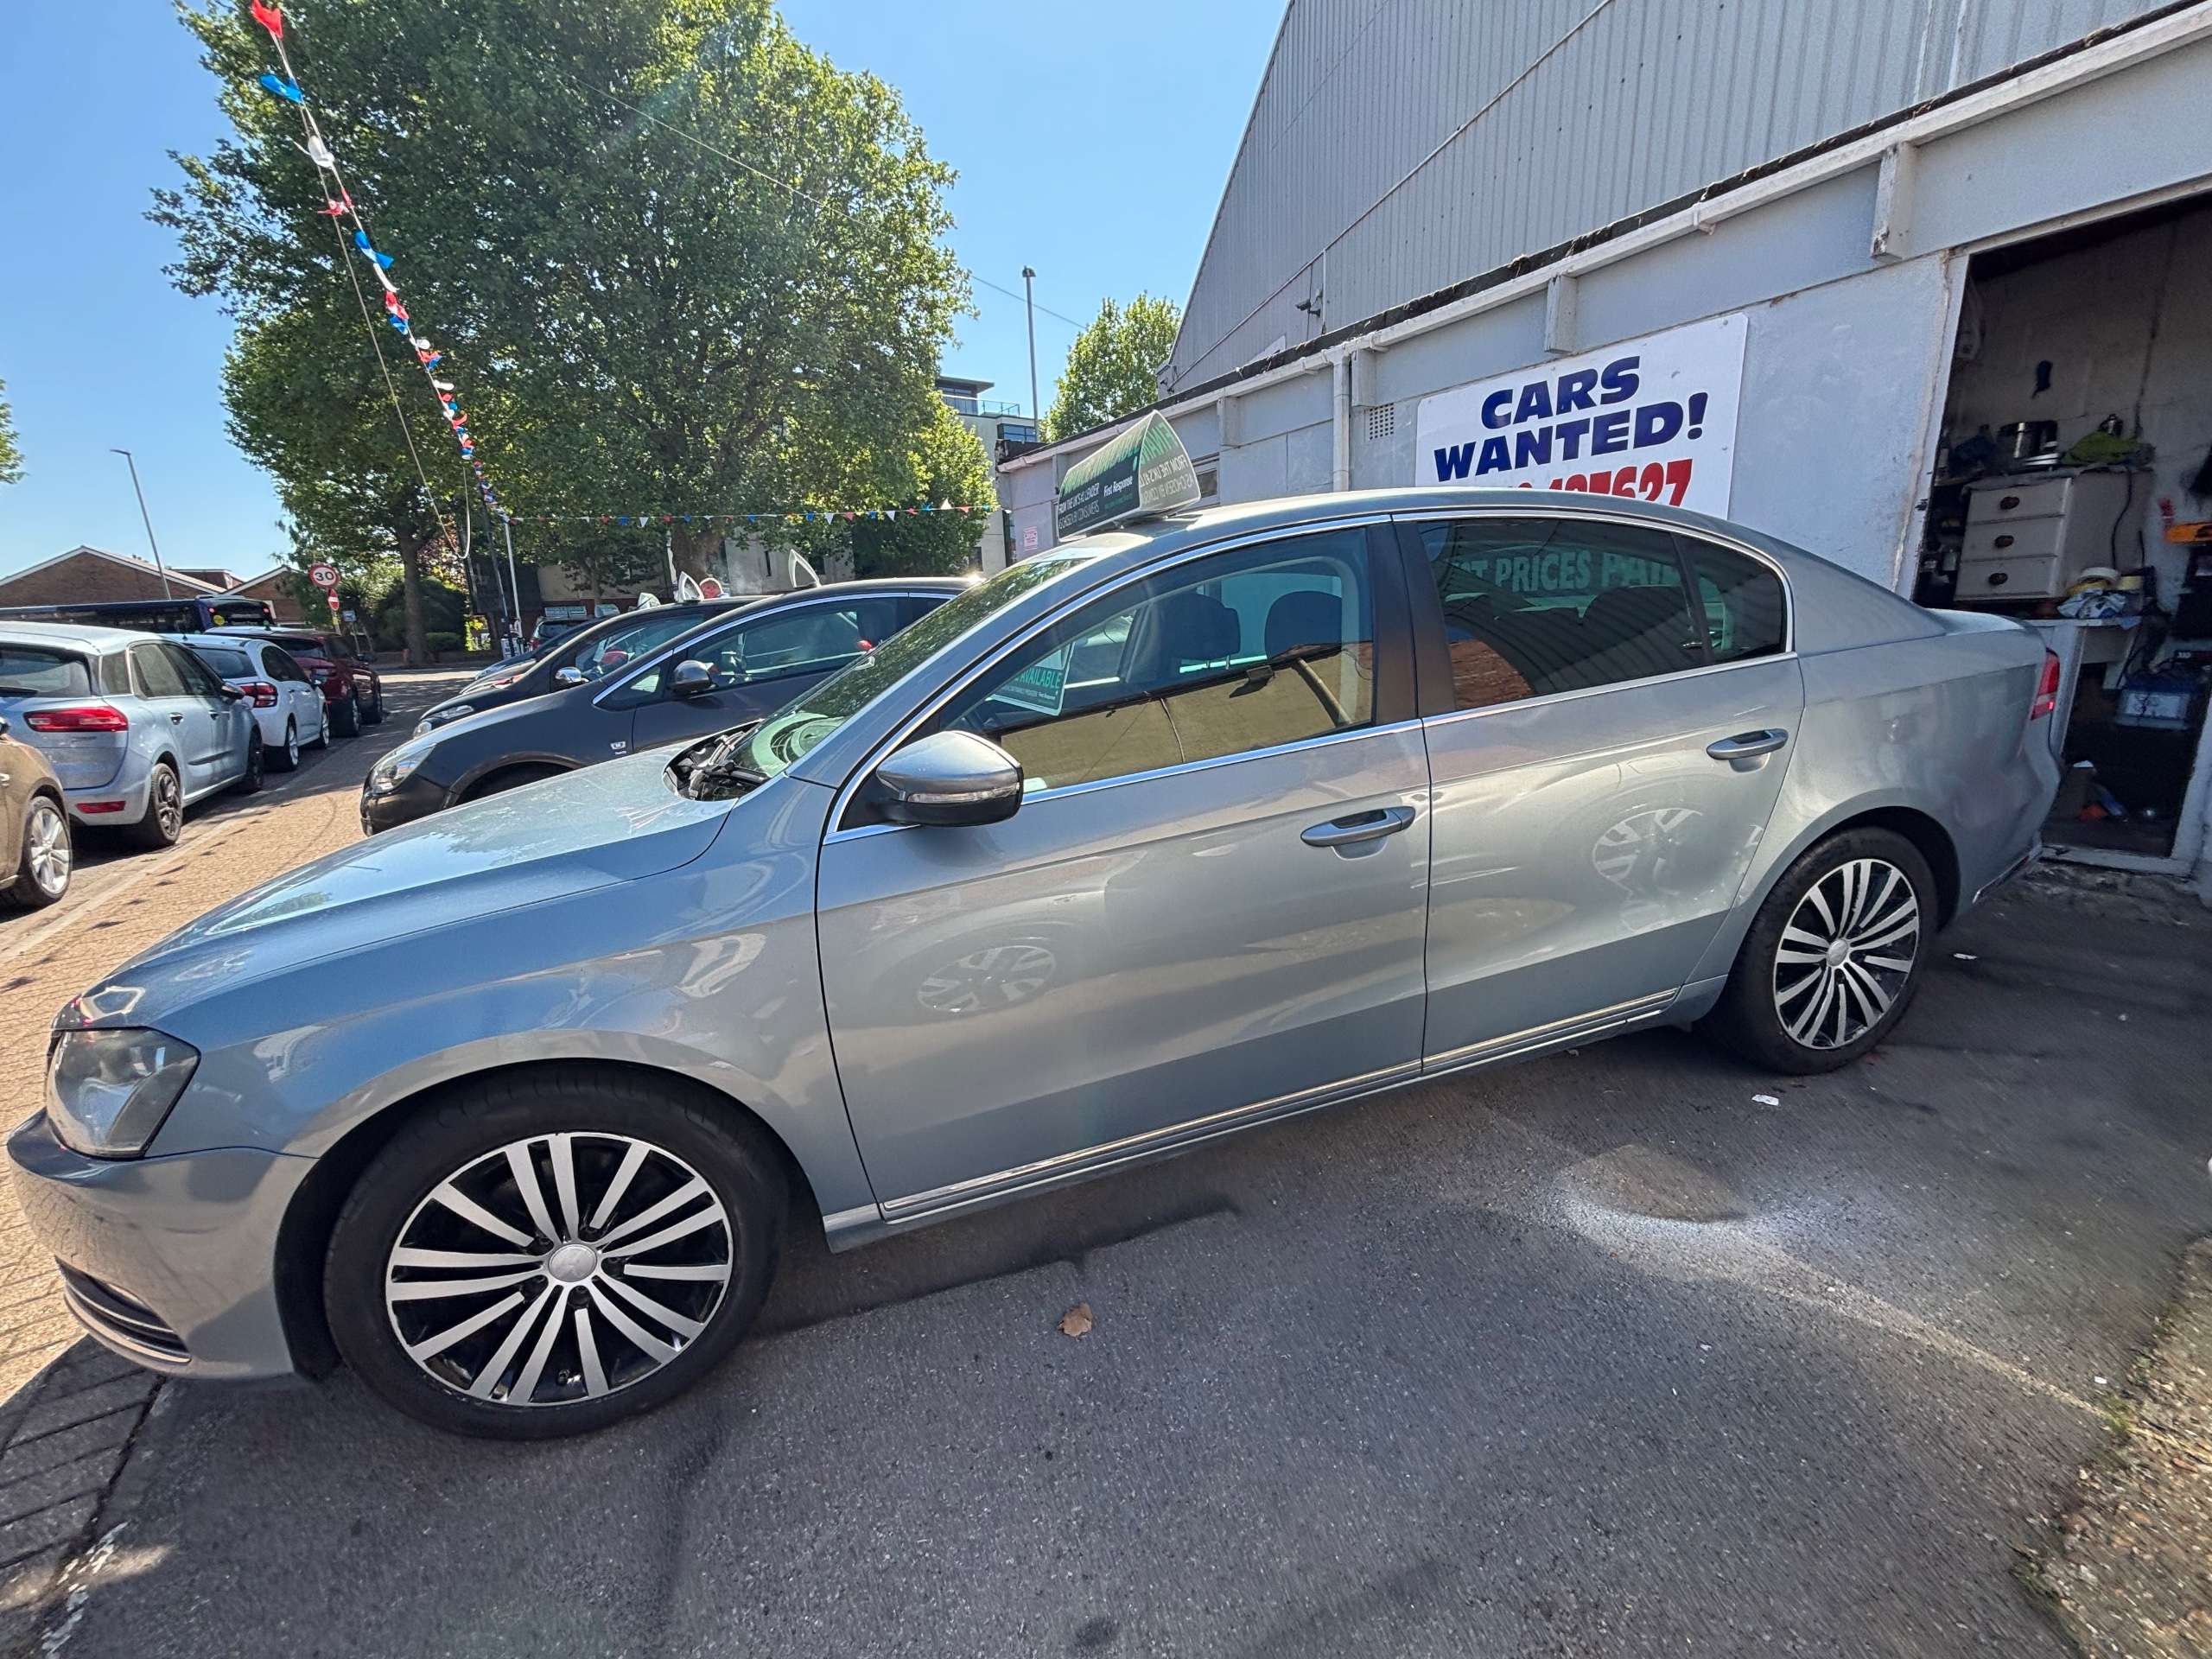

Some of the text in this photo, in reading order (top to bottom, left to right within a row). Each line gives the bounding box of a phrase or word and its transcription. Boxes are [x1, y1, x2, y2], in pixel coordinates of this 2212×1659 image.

[1481, 355, 1641, 430] CARS
[1433, 391, 1709, 483] WANTED!
[315, 571, 334, 582] 30
[1495, 550, 1592, 593] PRICES
